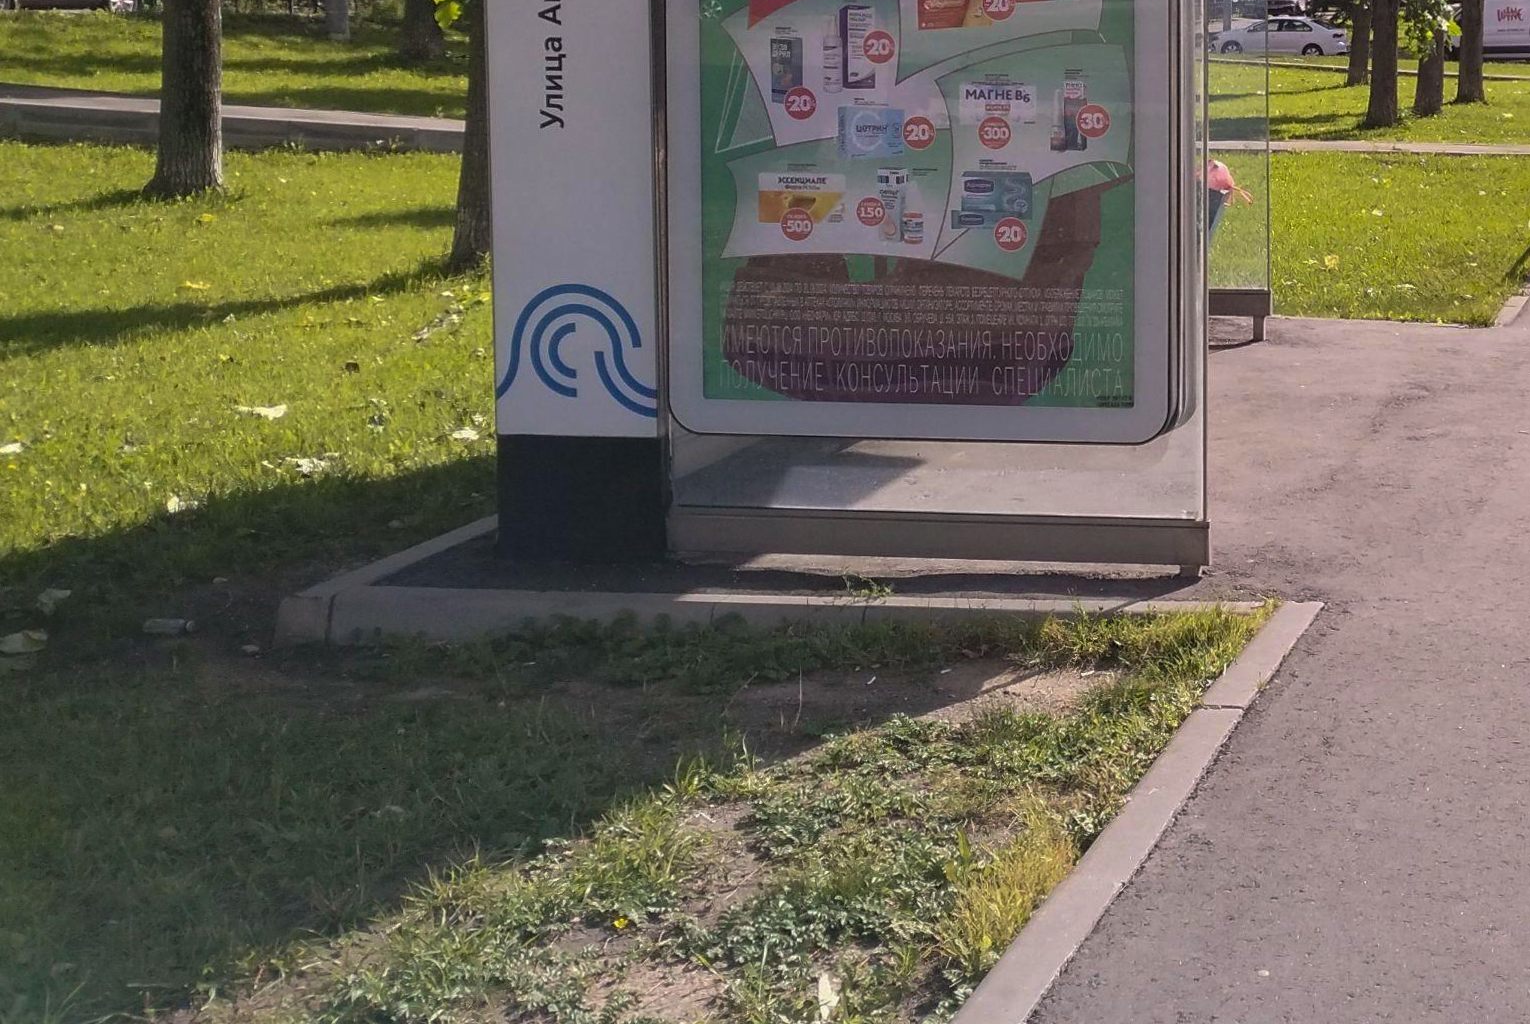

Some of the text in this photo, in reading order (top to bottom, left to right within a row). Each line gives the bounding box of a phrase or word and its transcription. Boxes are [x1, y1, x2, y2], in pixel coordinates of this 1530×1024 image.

[539, 36, 567, 129] Улица
[965, 88, 1012, 101] МАГНЕ
[719, 325, 1124, 363] ИМЕЮТСЯ ПРОТИВОПОКАЗАНИЯ. НЕОБХОДИМО
[719, 359, 1124, 400] ПОЛУЧЕНИЕ КОНСУЛЬТАЦИИ СПЕЦИАЛИСТА
